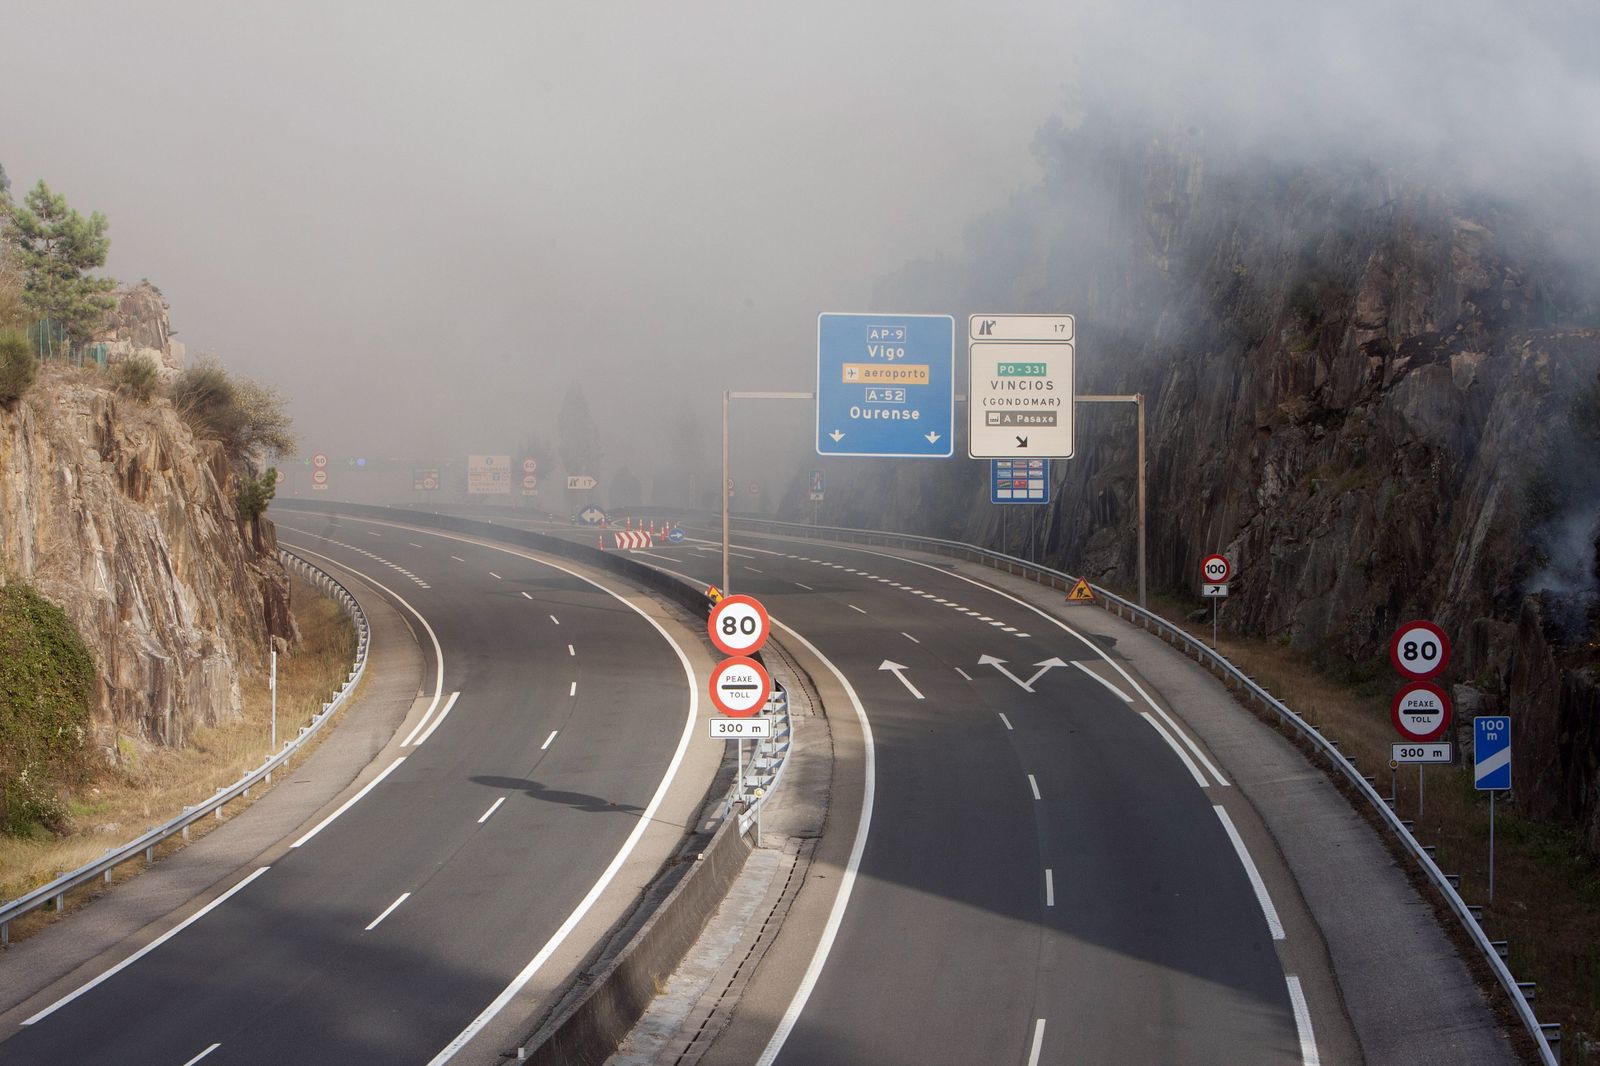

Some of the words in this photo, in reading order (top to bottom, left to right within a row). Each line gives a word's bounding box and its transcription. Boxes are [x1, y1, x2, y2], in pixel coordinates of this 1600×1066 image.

[1053, 324, 1066, 333] 17
[870, 329, 904, 340] AP-9
[868, 345, 905, 361] Vigo
[864, 368, 926, 381] aeroporto
[999, 365, 1046, 374] PO-331
[991, 380, 1054, 391] VINCIOS
[868, 390, 904, 401] A-52
[982, 397, 1061, 407] (GONDOMAR)
[849, 406, 920, 420] Ourense
[1004, 414, 1011, 423] A
[1016, 414, 1054, 423] Pasaxe
[1205, 564, 1225, 574] 100
[722, 615, 756, 636] 80
[1403, 641, 1437, 661] 80
[726, 675, 753, 683] PEAXE
[729, 691, 750, 699] TOLL
[1407, 700, 1434, 708] PEAXE
[719, 723, 743, 733] 300
[751, 725, 761, 733] m
[1480, 720, 1504, 731] 100
[1487, 732, 1498, 741] m
[1400, 748, 1424, 758] 300
[1432, 750, 1443, 758] m
